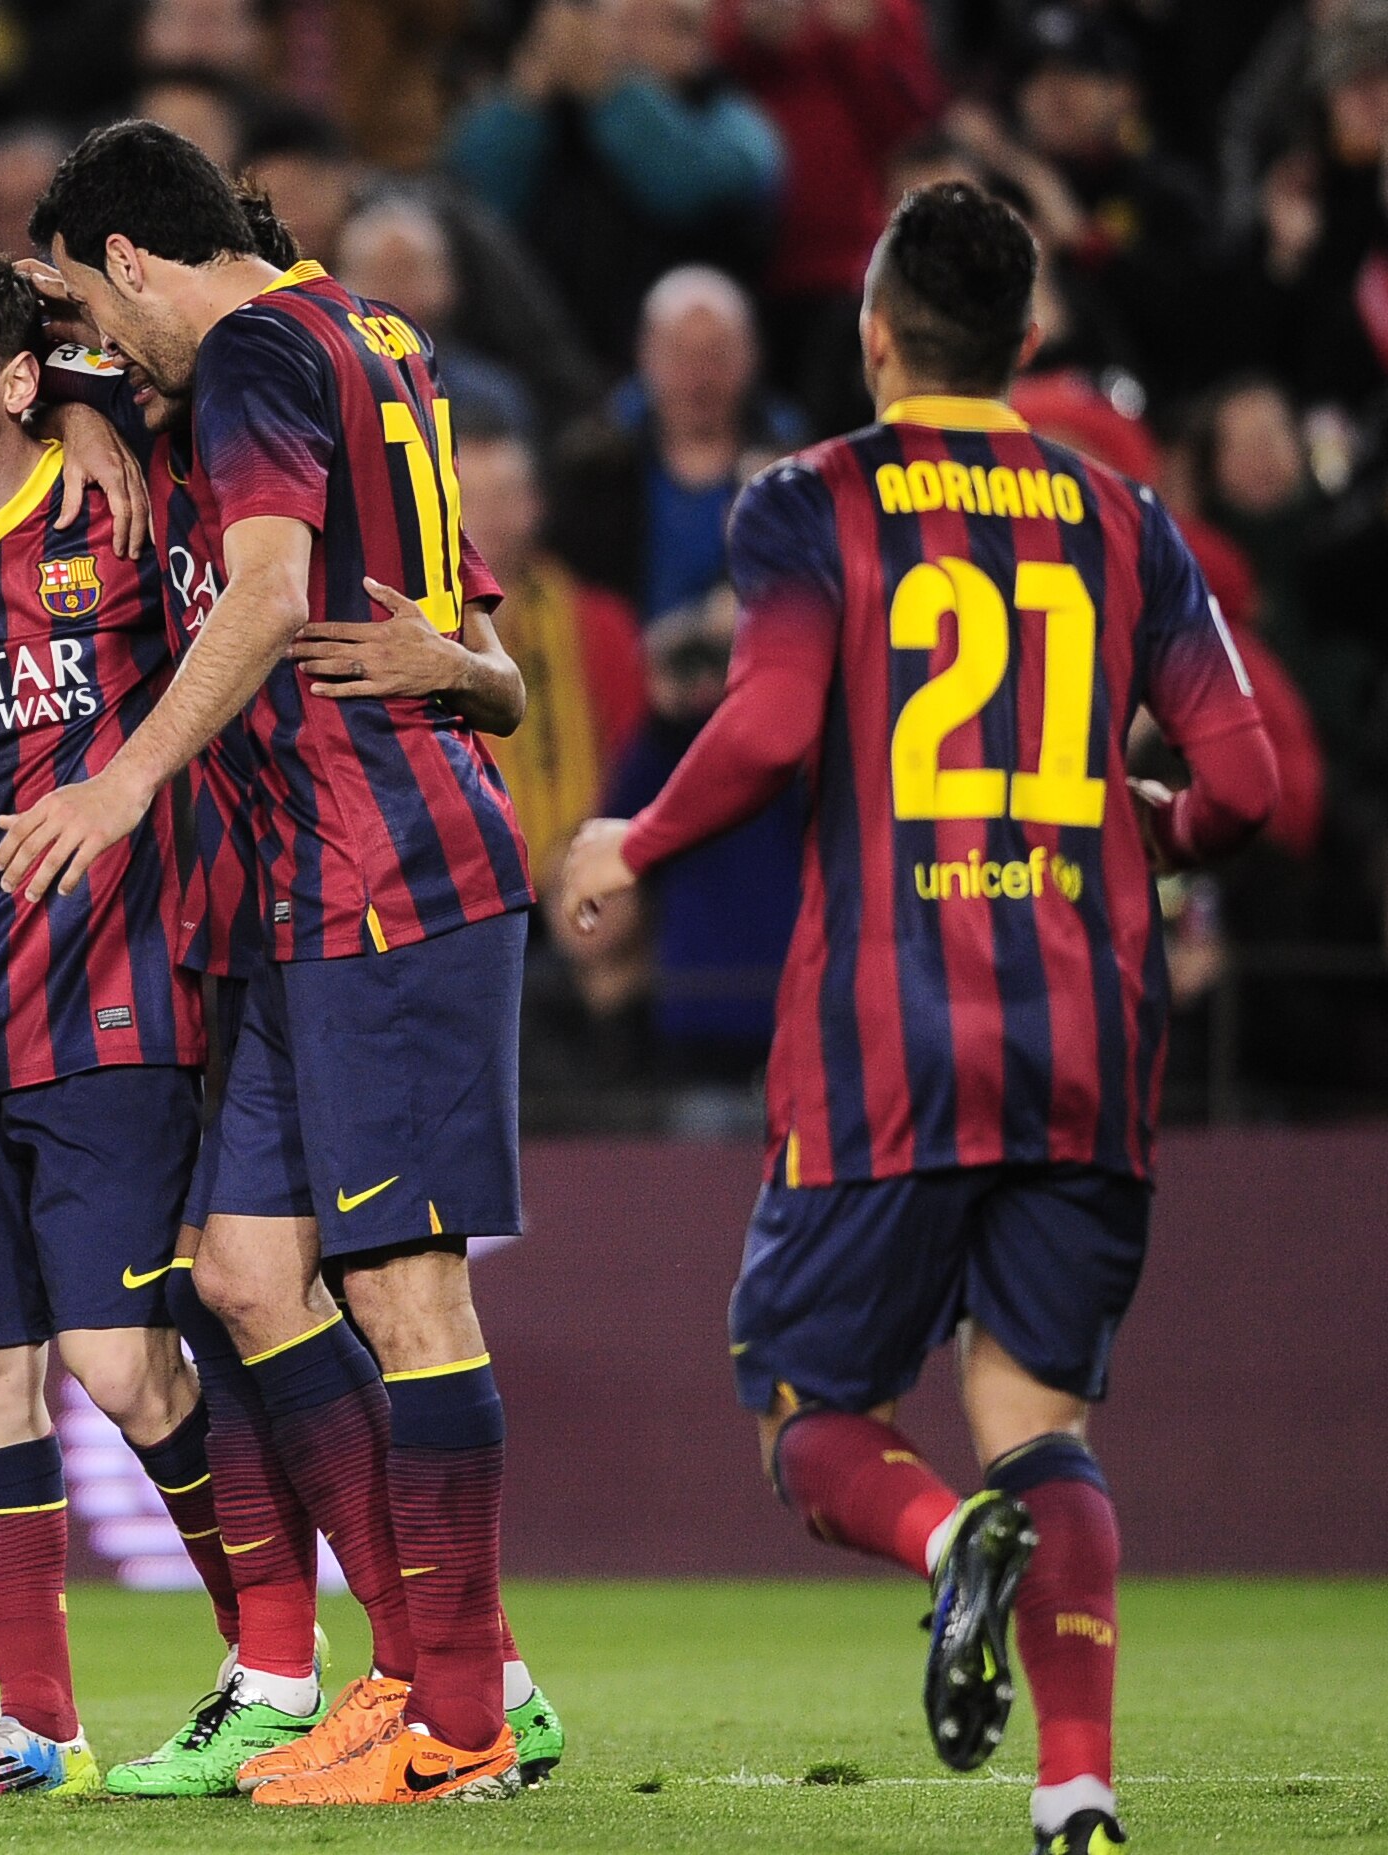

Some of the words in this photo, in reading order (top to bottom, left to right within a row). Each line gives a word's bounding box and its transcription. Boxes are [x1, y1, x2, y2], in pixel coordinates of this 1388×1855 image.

[875, 460, 1085, 525] ADRIANO
[890, 555, 1107, 828] 21
[914, 845, 1049, 900] unicef
